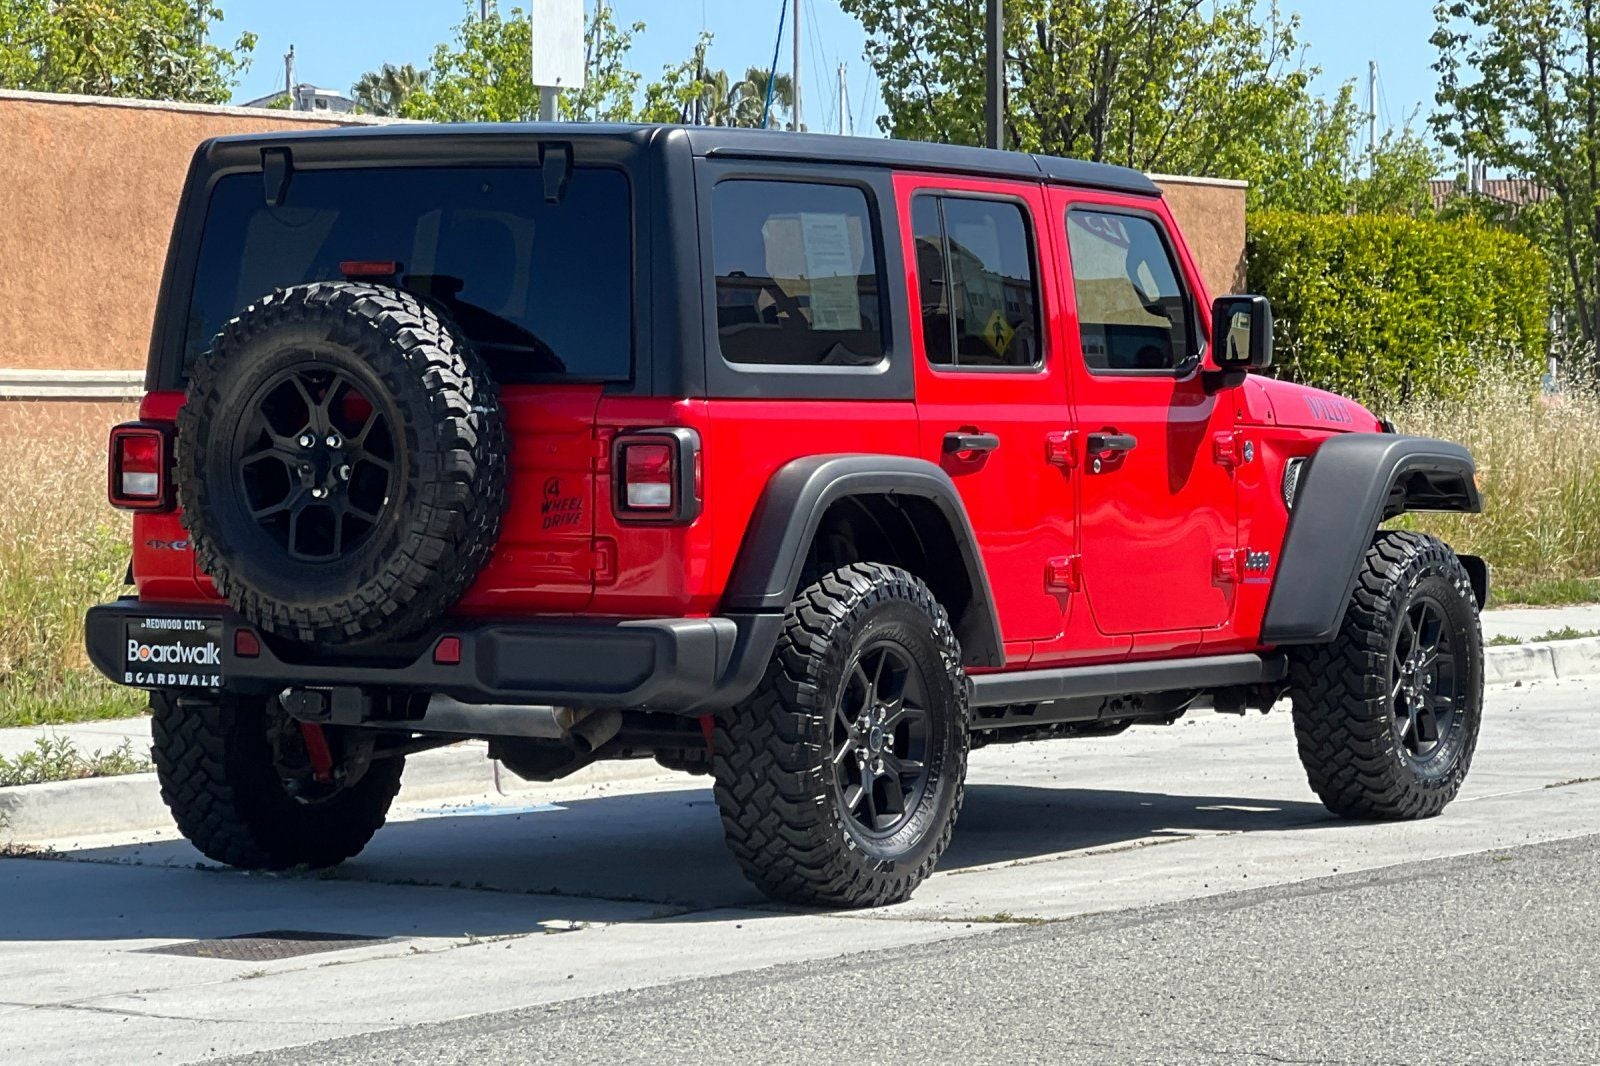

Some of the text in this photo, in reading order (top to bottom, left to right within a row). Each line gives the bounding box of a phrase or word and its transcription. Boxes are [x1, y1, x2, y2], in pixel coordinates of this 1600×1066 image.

[541, 497, 584, 515] WHEEL
[543, 511, 583, 531] DRIVE
[145, 618, 202, 630] REDWOOD CITY
[127, 639, 221, 665] Boardwalk
[124, 671, 220, 687] BOARDWALK
